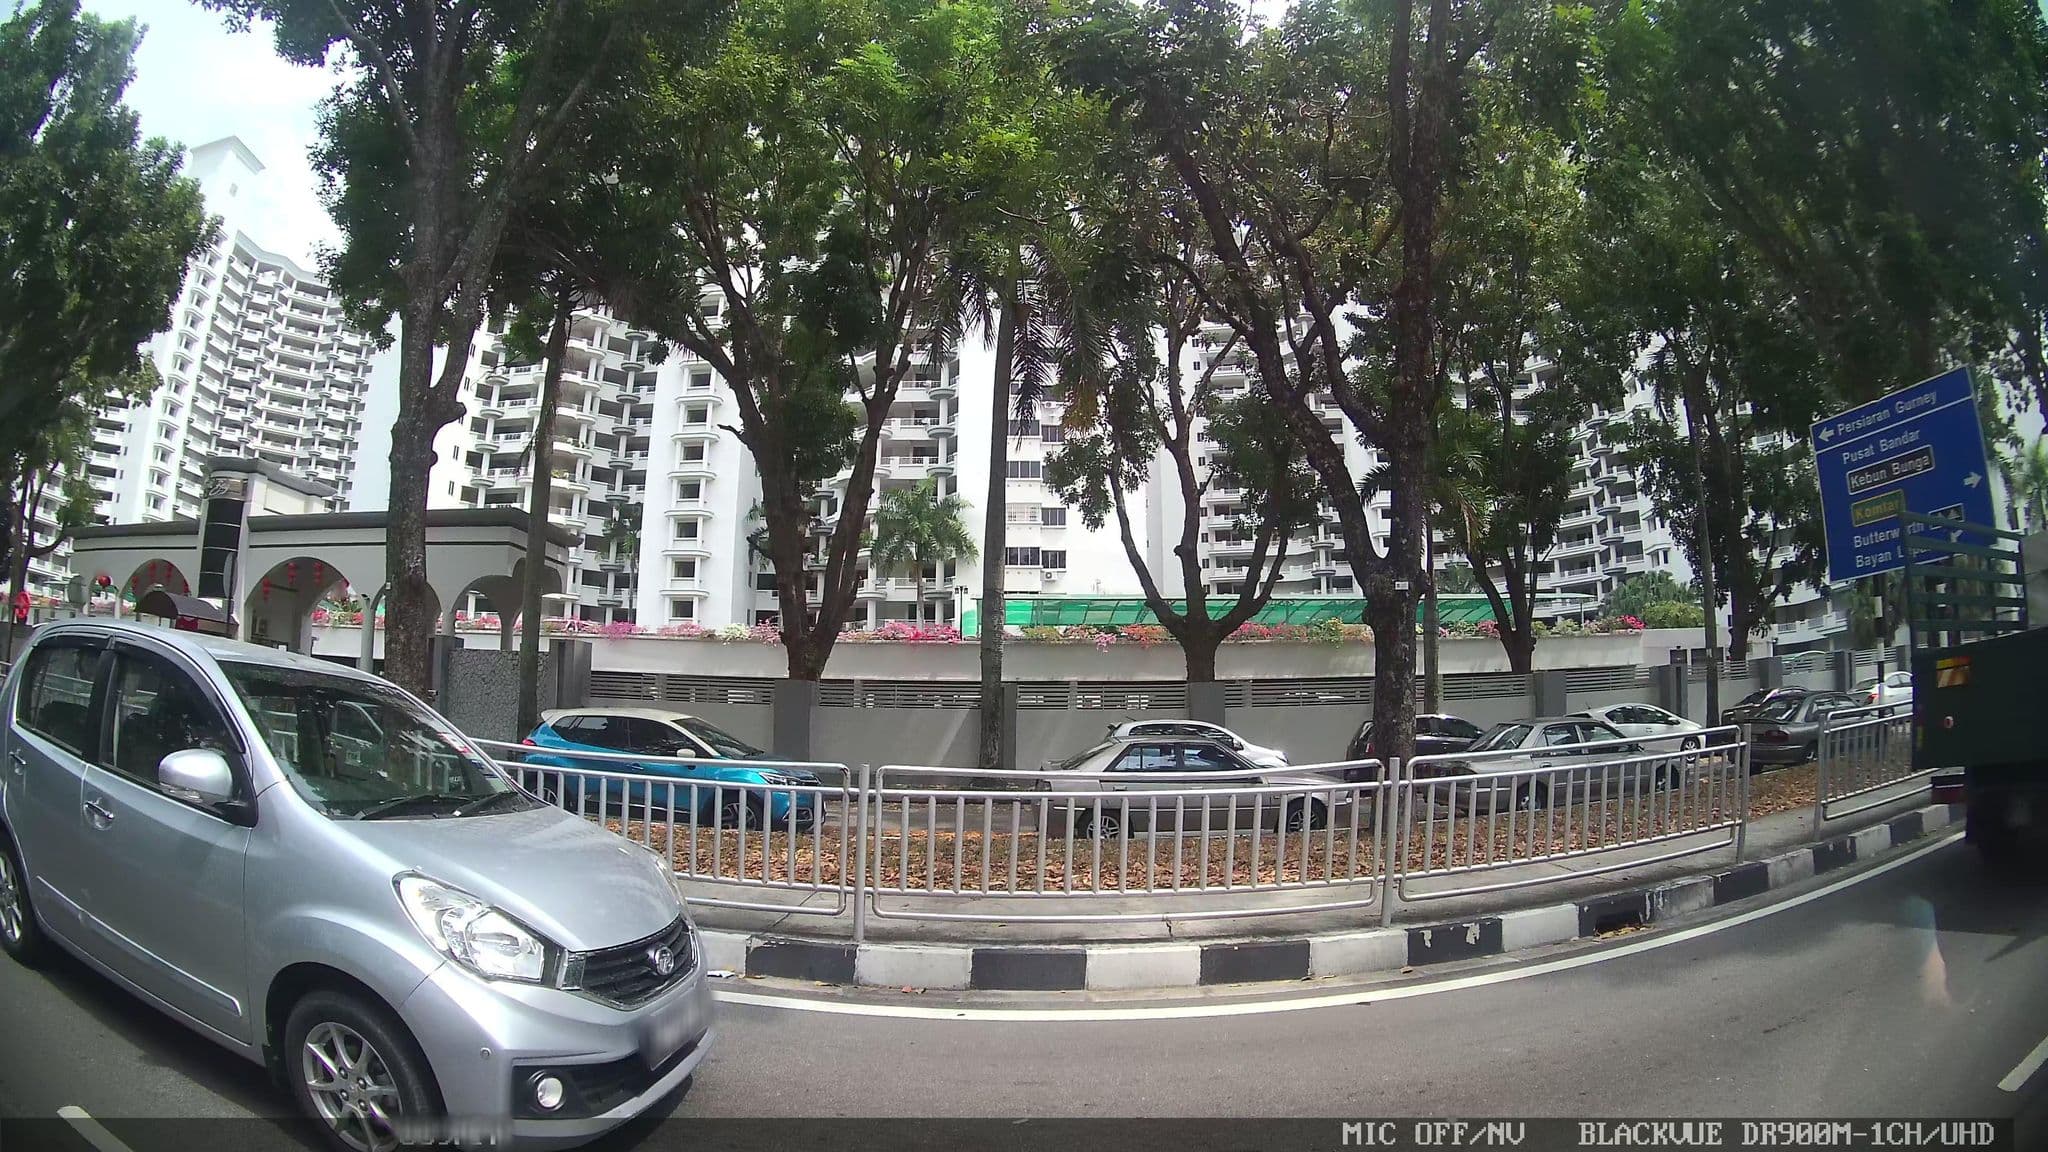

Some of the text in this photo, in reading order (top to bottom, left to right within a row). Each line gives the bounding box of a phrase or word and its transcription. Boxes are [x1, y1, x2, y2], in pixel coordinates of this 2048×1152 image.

[1837, 392, 1937, 435] Persiaran Gurney
[1842, 430, 1920, 464] Pusat Bandar
[1850, 455, 1930, 488] Kebun Bunga
[1853, 522, 1924, 548] Butterwrth
[1855, 551, 1892, 568] Bayan
